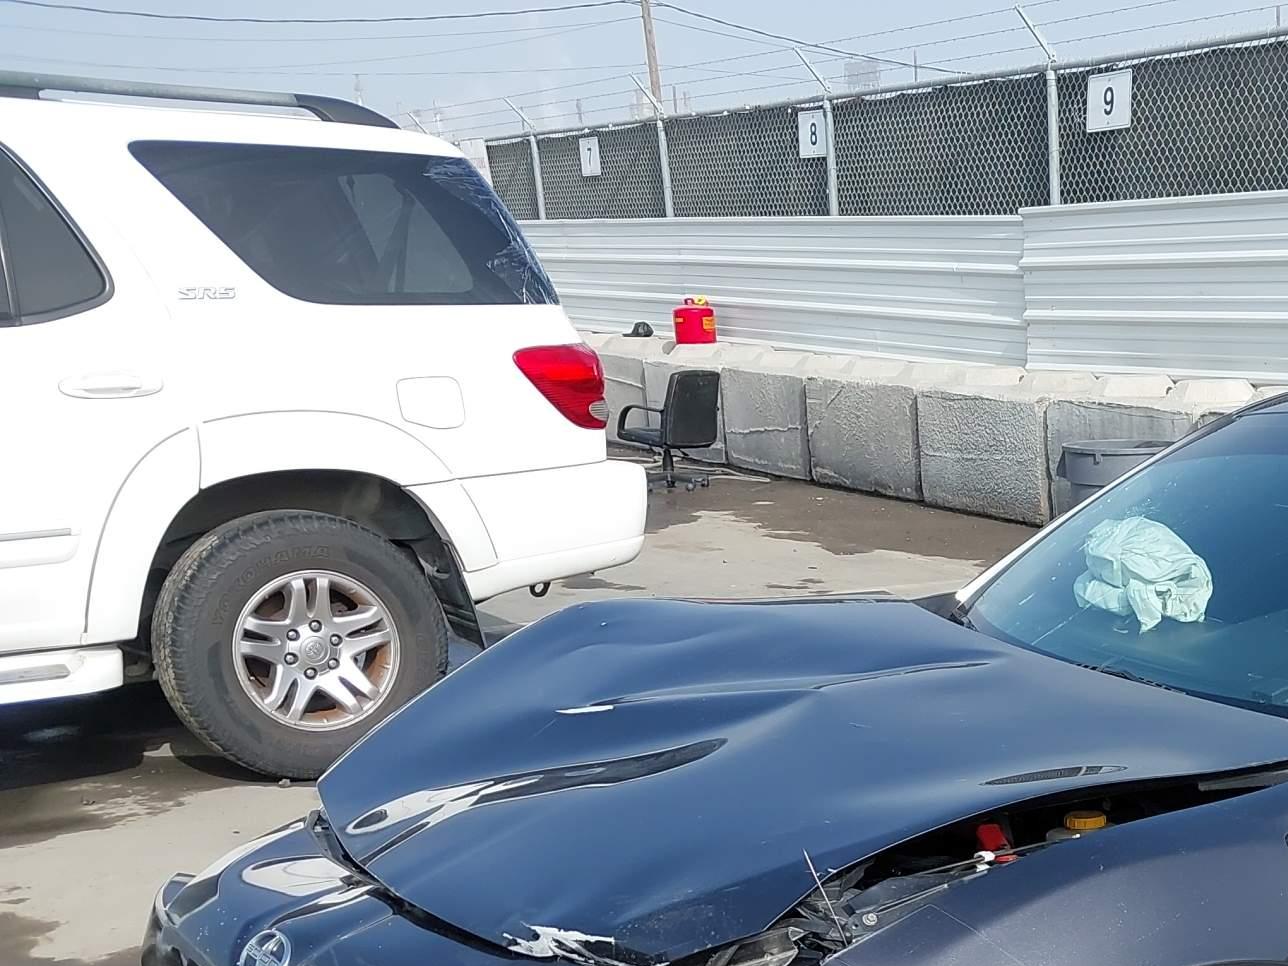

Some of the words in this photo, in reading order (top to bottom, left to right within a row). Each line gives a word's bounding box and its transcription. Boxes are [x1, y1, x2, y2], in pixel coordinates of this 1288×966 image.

[1103, 86, 1114, 116] 9
[810, 122, 818, 146] 8
[586, 147, 592, 167] 7
